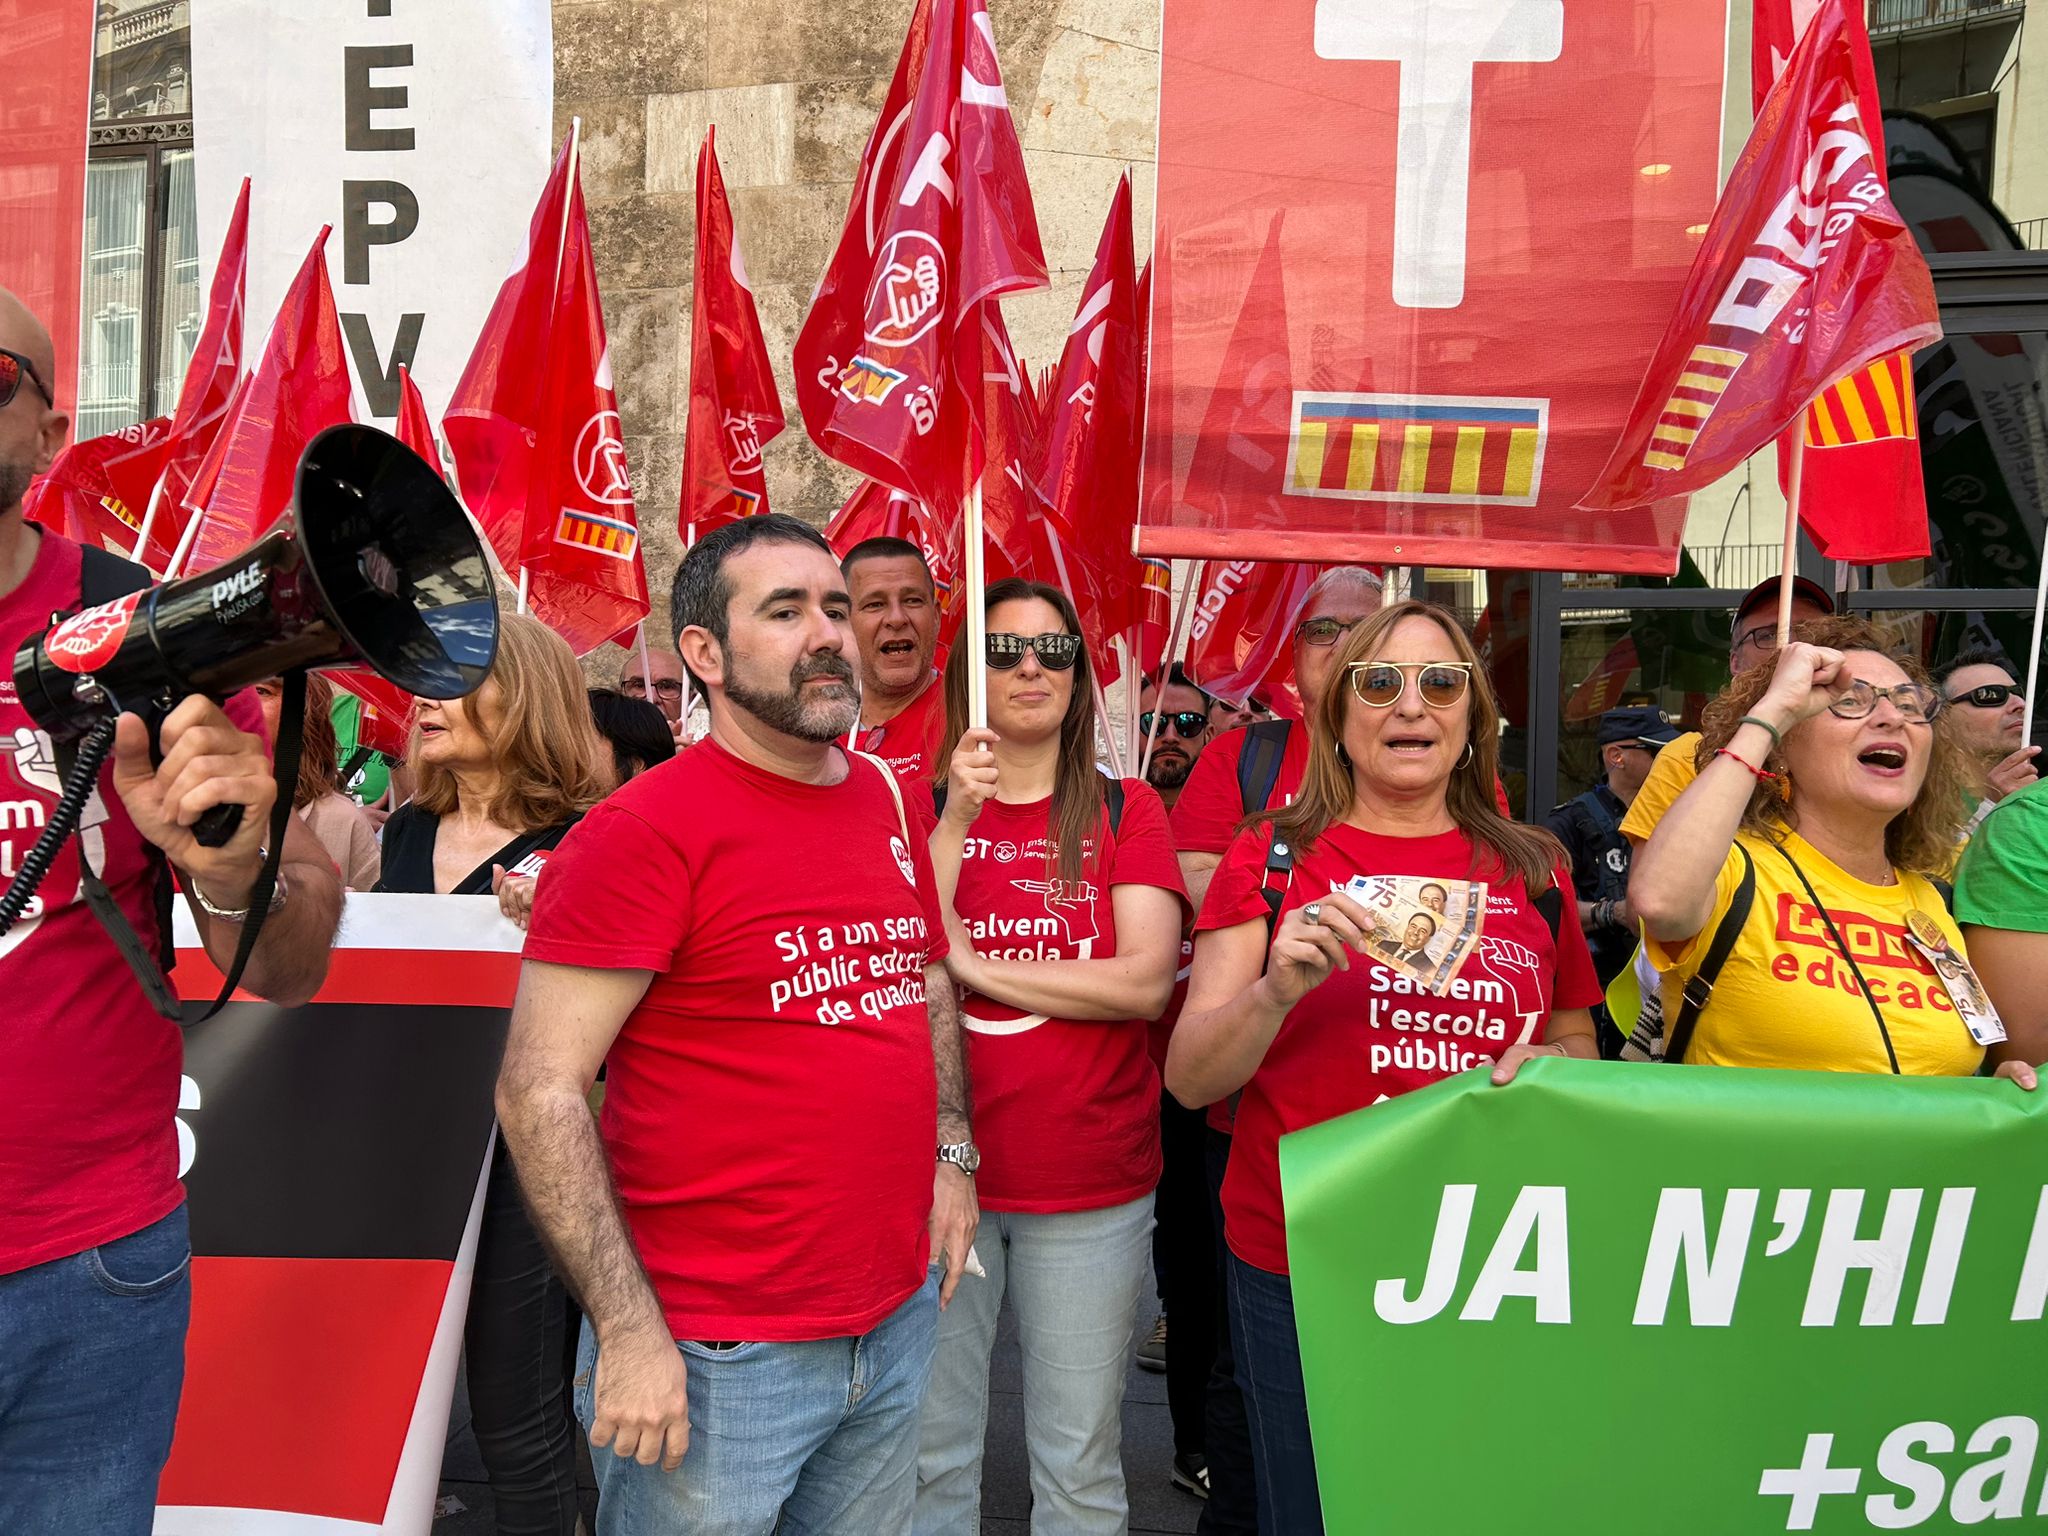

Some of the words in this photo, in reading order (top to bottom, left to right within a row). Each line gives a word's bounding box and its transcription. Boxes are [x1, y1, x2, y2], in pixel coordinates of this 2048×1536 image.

[339, 0, 425, 418] EPV
[962, 838, 992, 860] GT
[1368, 884, 1397, 909] 75
[774, 926, 809, 962] Sí
[817, 927, 835, 951] a
[842, 921, 880, 945] un
[883, 916, 928, 941] serv
[770, 954, 862, 1013] públic
[1369, 965, 1504, 1003] Saem
[1772, 953, 1953, 1011] educac
[816, 997, 855, 1025] de
[1371, 1037, 1493, 1074] públic
[1373, 1184, 1572, 1325] JA
[1631, 1187, 1976, 1327] N'HI
[1758, 1416, 2048, 1530] +sa
